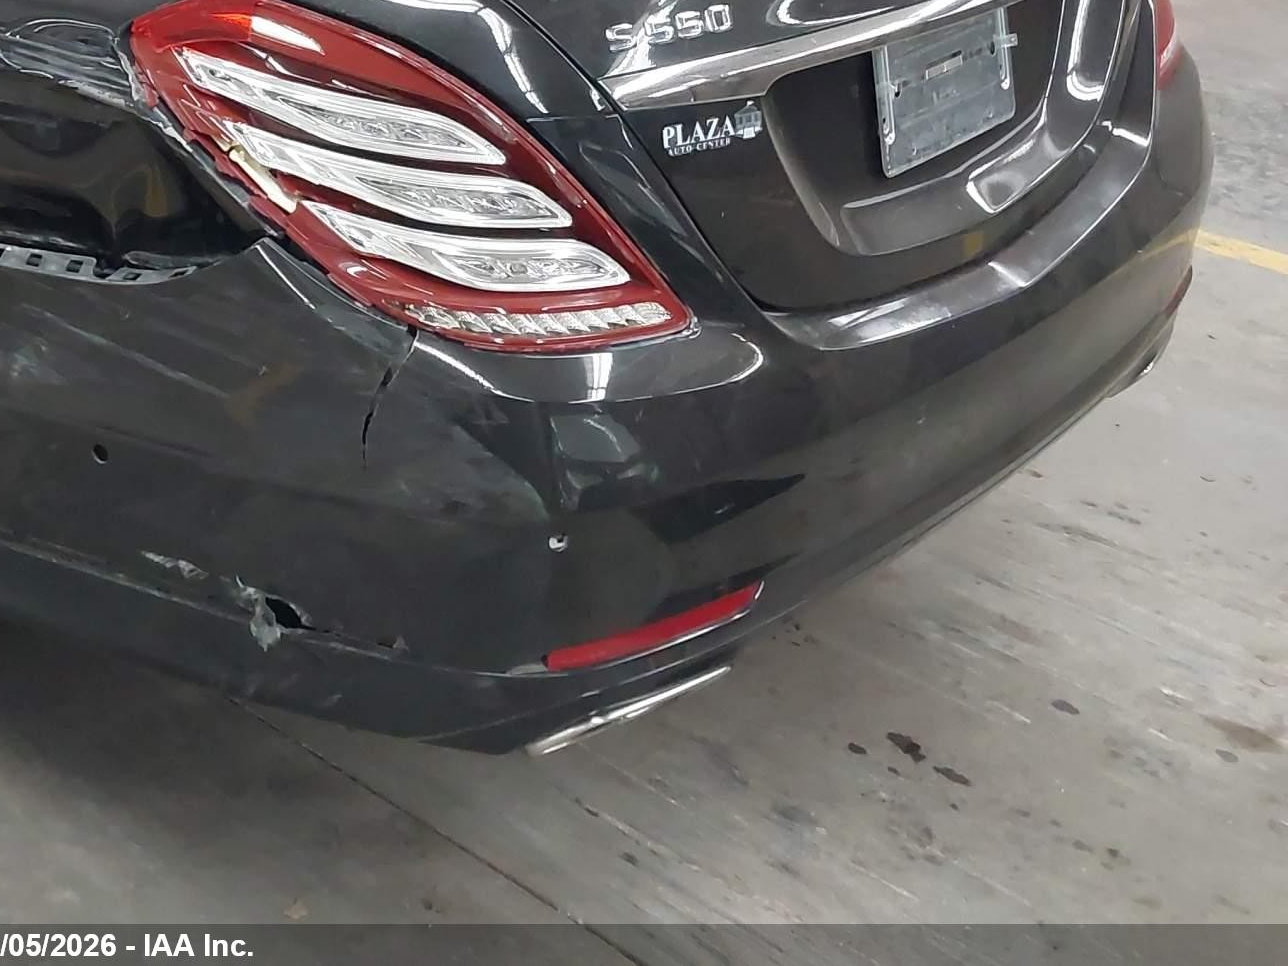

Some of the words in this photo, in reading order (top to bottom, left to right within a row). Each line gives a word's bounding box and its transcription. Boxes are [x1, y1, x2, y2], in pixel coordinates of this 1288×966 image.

[662, 115, 735, 149] PLAZA
[667, 144, 693, 156] AUTO
[696, 137, 731, 152] CENTER
